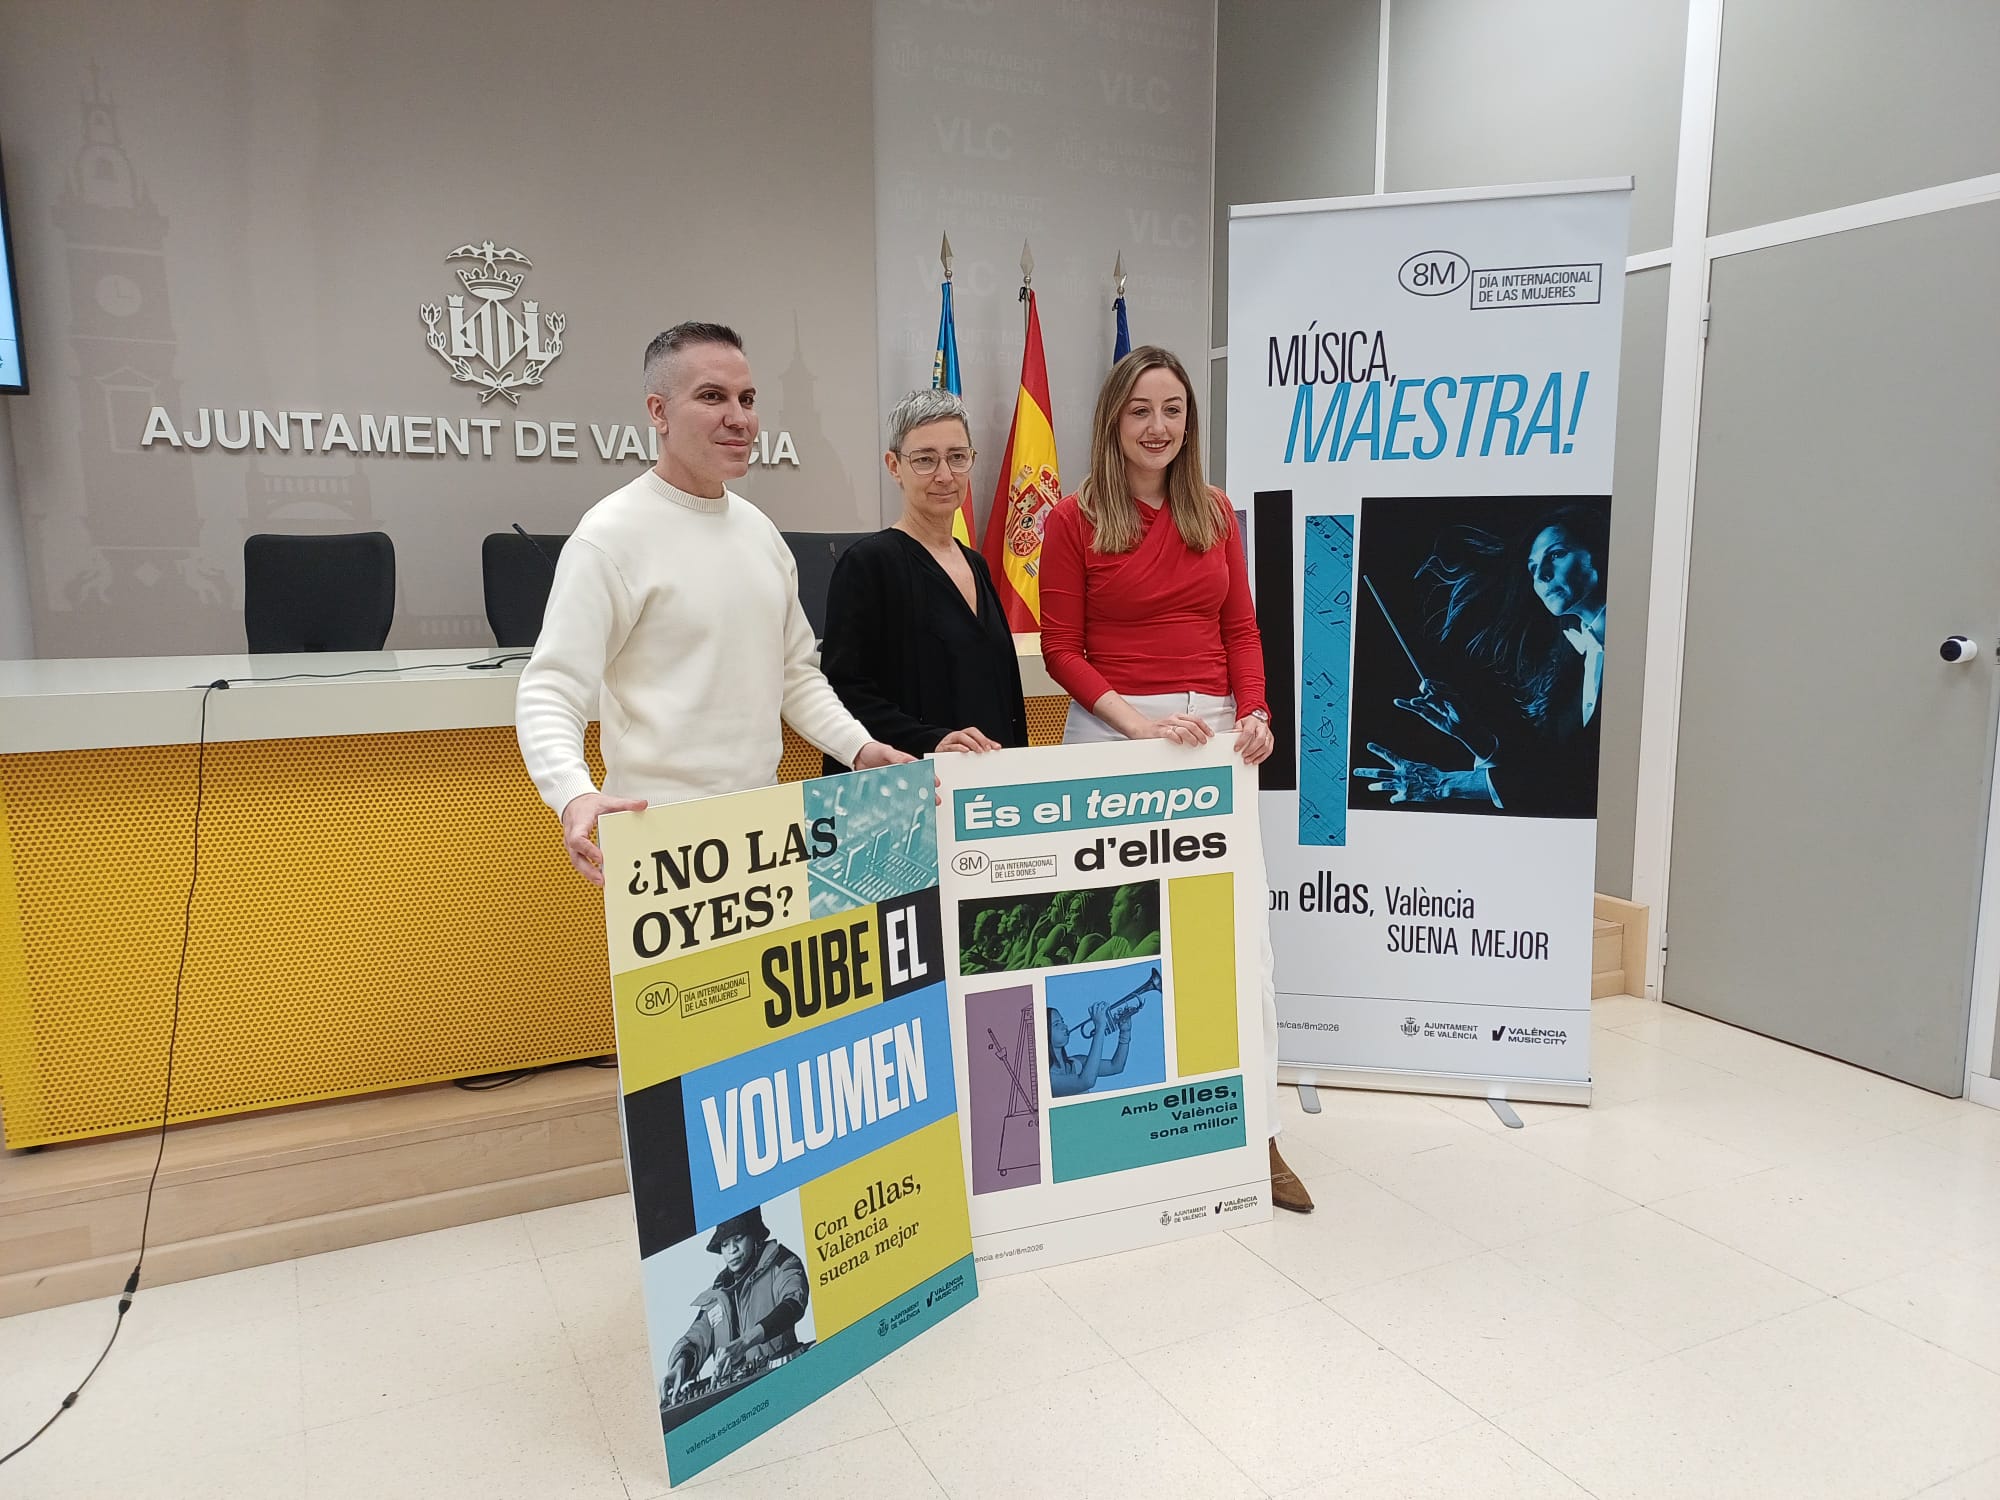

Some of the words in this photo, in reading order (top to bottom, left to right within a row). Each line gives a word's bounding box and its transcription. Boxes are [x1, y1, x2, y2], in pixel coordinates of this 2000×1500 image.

[1413, 261, 1455, 286] 8M
[1479, 274, 1499, 289] DÍA
[1502, 271, 1593, 287] INTERNACIONAL
[1479, 290, 1493, 303] DE
[1496, 289, 1518, 302] LAS
[1521, 286, 1576, 300] MUJERES
[1268, 320, 1397, 387] MÚSICA,
[1284, 371, 1590, 463] MAESTRA!
[140, 406, 500, 457] AJUNTAMENT
[514, 420, 579, 460] DE
[964, 794, 1021, 830] És
[1033, 794, 1071, 824] el
[1086, 785, 1220, 820] tempo
[628, 838, 729, 895] ¿NO
[746, 816, 838, 874] LAS
[1073, 828, 1227, 872] d'elles
[959, 856, 982, 871] 8M
[995, 871, 1003, 879] DE
[1004, 870, 1015, 878] LES
[1016, 868, 1036, 877] DONES
[1006, 859, 1053, 870] INTERNACIONAL
[1269, 890, 1289, 911] on
[1299, 870, 1375, 917] ellas,
[1384, 886, 1475, 919] València
[632, 884, 794, 958] OYES?
[1386, 924, 1459, 956] SUENA
[1471, 928, 1549, 961] MEJOR
[761, 920, 873, 1029] SUBE
[885, 905, 928, 987] EL
[644, 987, 671, 1010] 8M
[684, 991, 696, 1003] DÍA
[696, 977, 747, 998] INTERNACIONAL
[685, 1003, 694, 1013] DE
[695, 999, 708, 1010] LAS
[708, 988, 738, 1005] MUJERES
[1424, 1022, 1479, 1032] AJUNTAMENT
[1424, 1030, 1435, 1038] DE
[1508, 1036, 1541, 1044] MUSIC
[1543, 1037, 1567, 1046] CITY
[701, 1017, 928, 1192] VOLUMEN
[1121, 1101, 1158, 1117] Amb
[1163, 1085, 1237, 1108] elles,
[1171, 1102, 1238, 1121] València
[1150, 1126, 1188, 1140] sona
[1193, 1116, 1238, 1132] millor
[814, 1215, 848, 1241] Con
[853, 1174, 921, 1220] ellas,
[1174, 1205, 1207, 1217] AJUNTAMENT
[1224, 1204, 1244, 1213] MUSIC
[1244, 1201, 1258, 1209] CITY
[816, 1217, 888, 1262] València
[819, 1250, 870, 1287] suena
[875, 1222, 919, 1256] mejor
